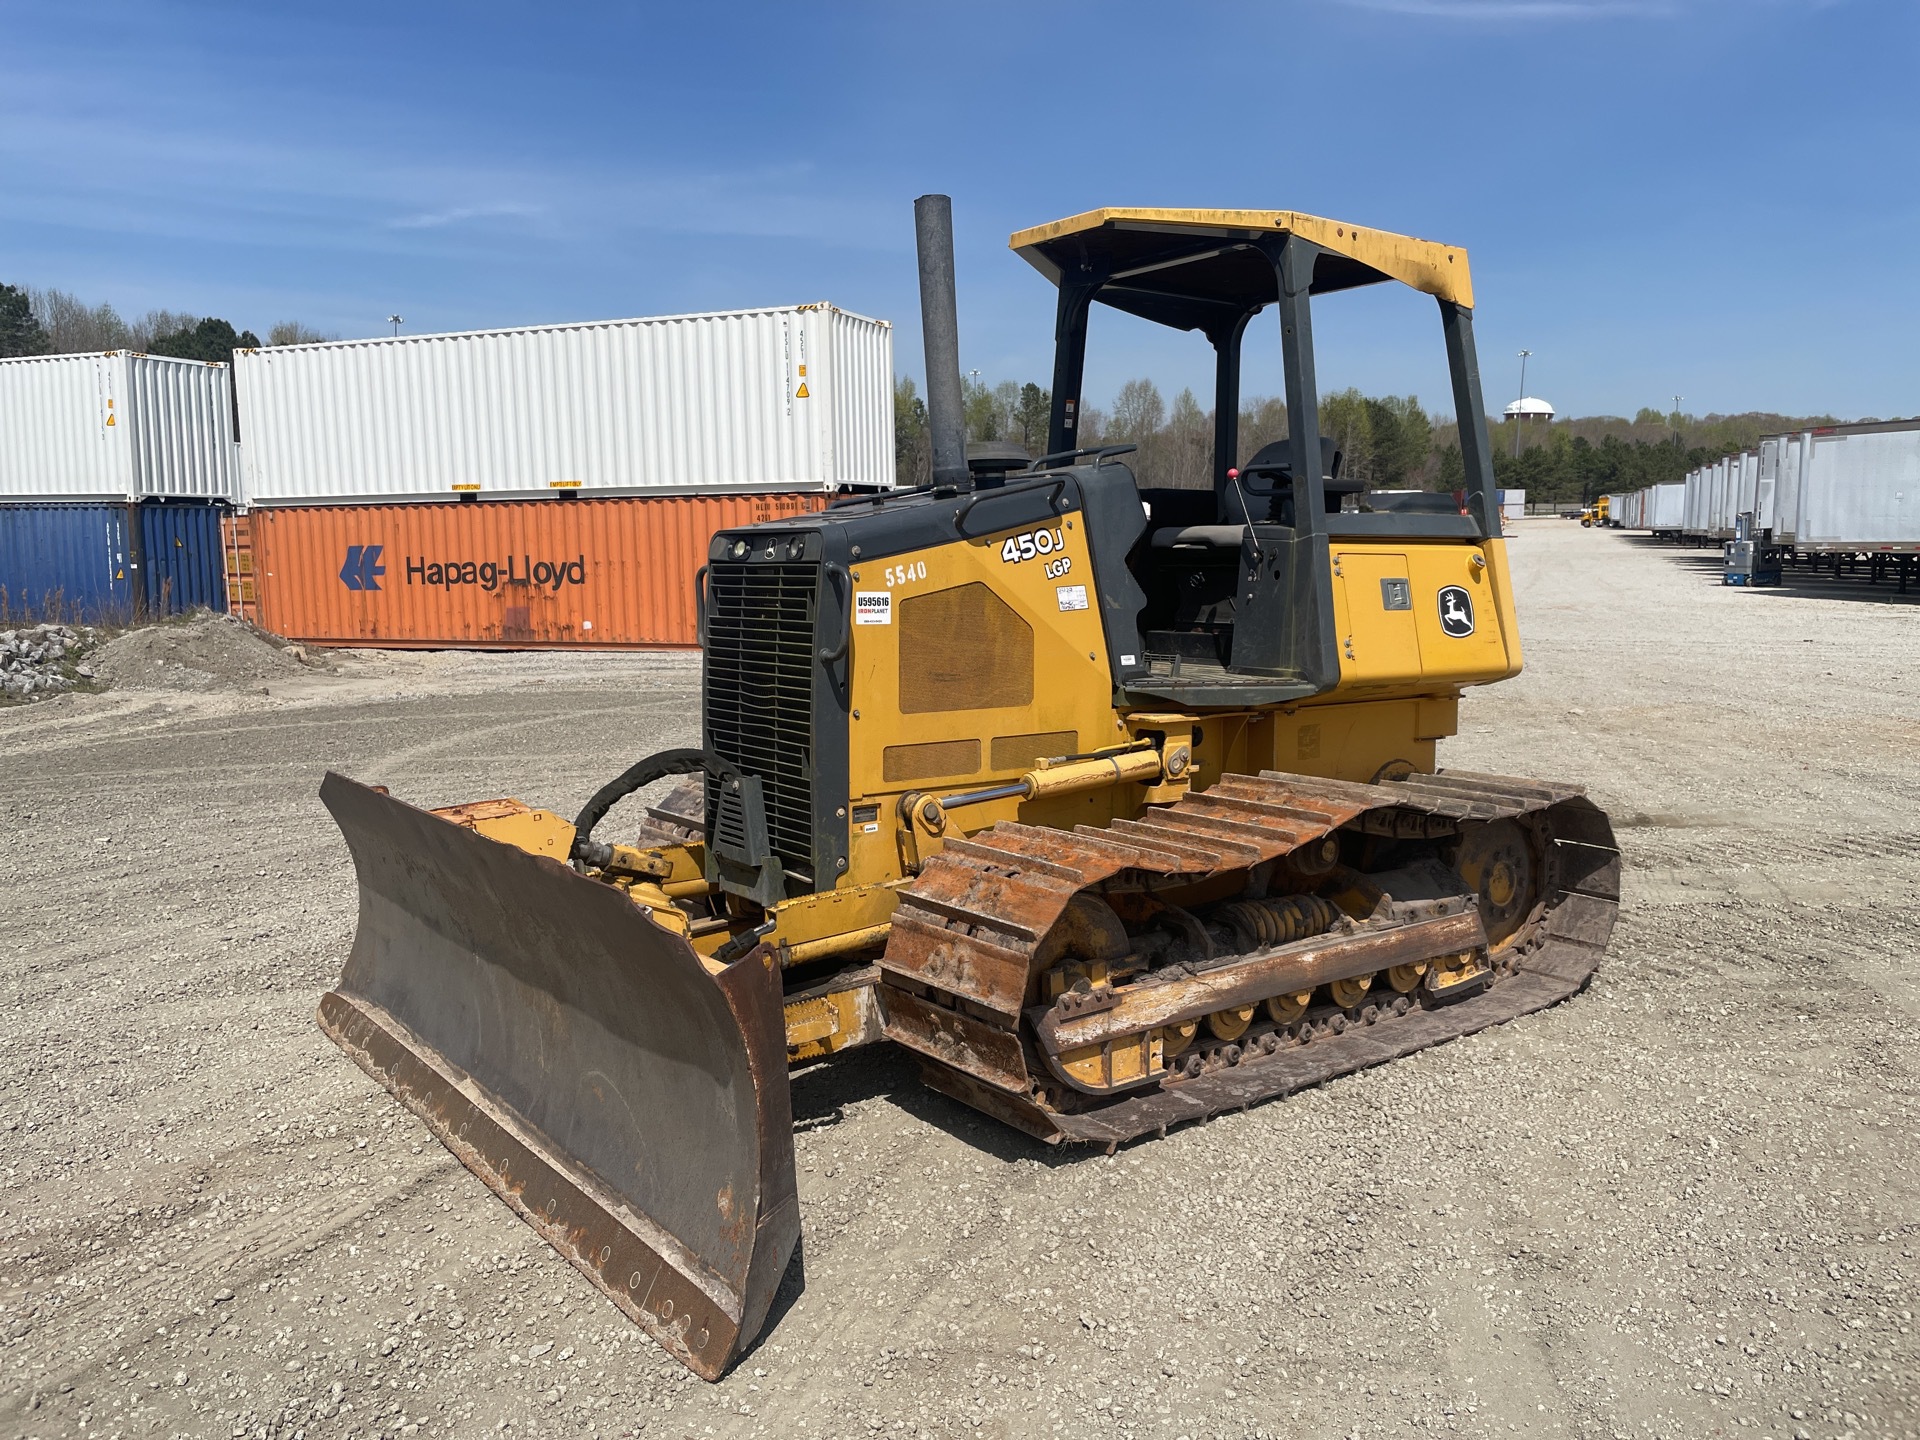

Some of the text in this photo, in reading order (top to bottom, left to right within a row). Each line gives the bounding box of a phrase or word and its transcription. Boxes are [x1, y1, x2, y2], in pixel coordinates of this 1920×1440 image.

[1001, 527, 1064, 564] 450J
[406, 555, 585, 592] Hapag-Lloyd
[885, 561, 927, 588] 5540
[1044, 556, 1072, 580] LGP
[858, 597, 889, 607] U595616
